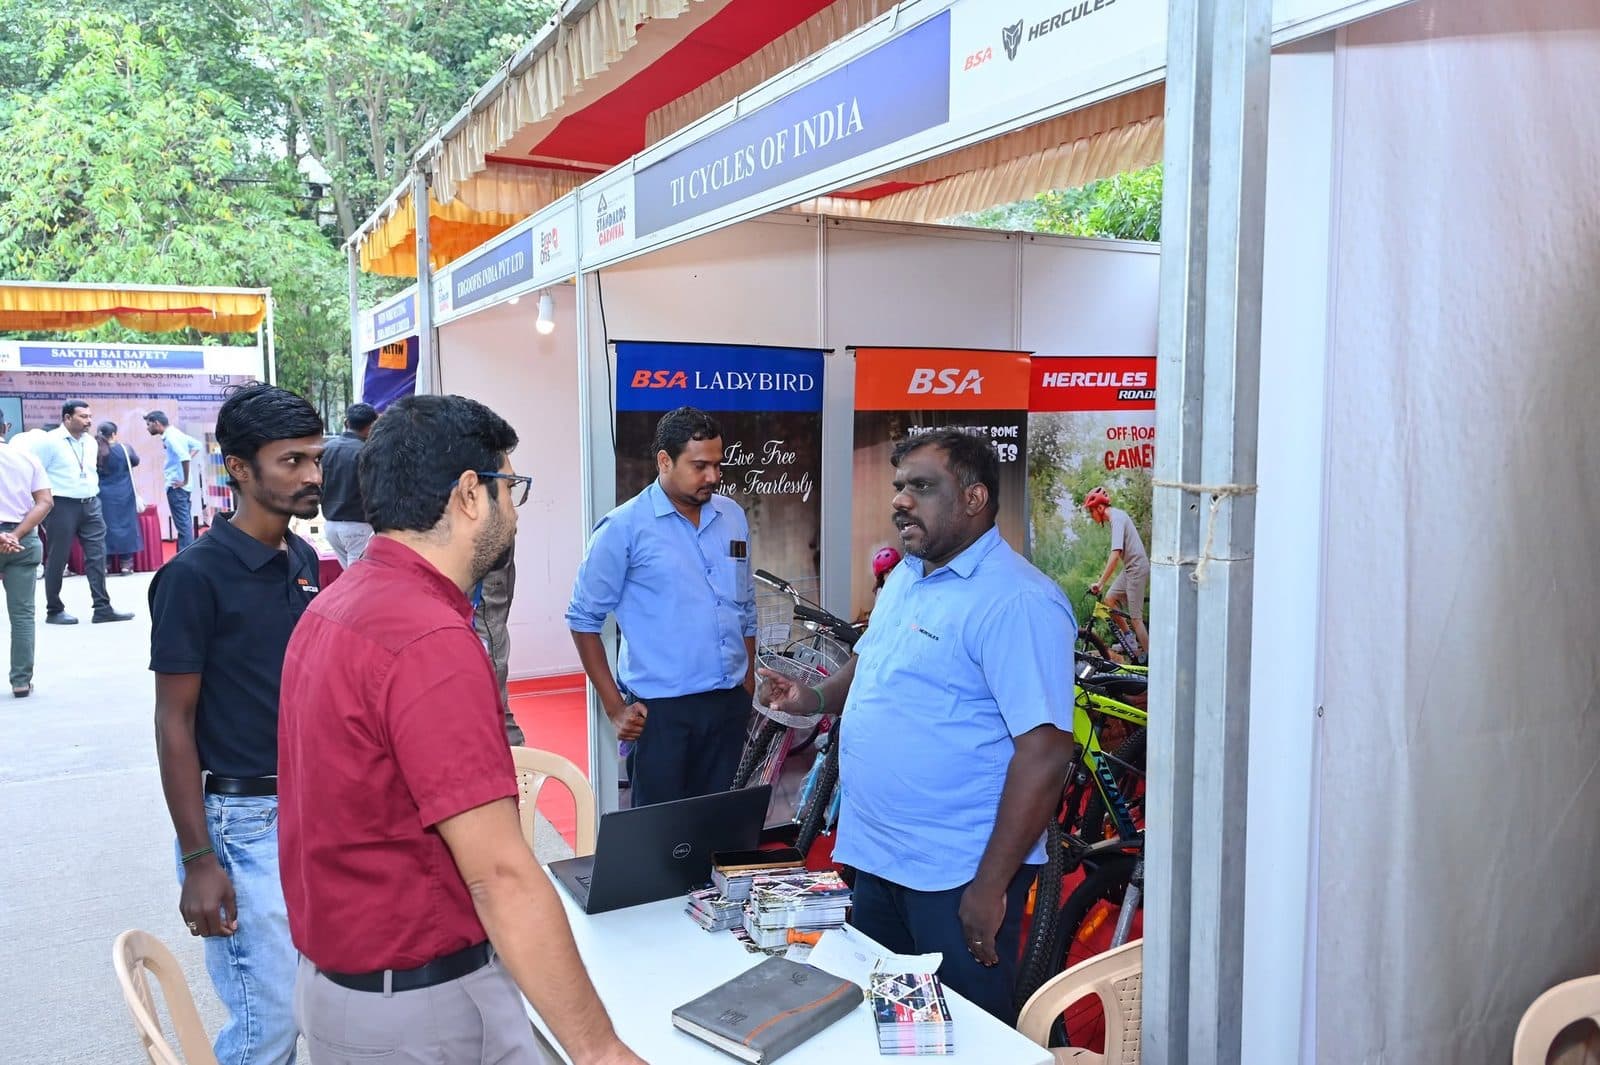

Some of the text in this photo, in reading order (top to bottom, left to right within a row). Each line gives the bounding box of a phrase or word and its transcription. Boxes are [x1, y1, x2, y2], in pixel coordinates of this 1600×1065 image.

[964, 47, 992, 71] BSA
[671, 96, 864, 207] TI CYCLES OF INDIA
[511, 251, 525, 273] LTD
[51, 348, 169, 360] SAKTHI SAI SAFETY
[73, 359, 150, 369] GLASS INDIA
[631, 370, 814, 392] BSA LADYBIRD
[907, 368, 984, 395] BSA
[1042, 372, 1148, 387] HERCULES
[991, 426, 1018, 437] SOME
[1107, 426, 1155, 441] OFF-ROA
[720, 439, 797, 466] Live Free
[743, 470, 813, 502] Fearlessly
